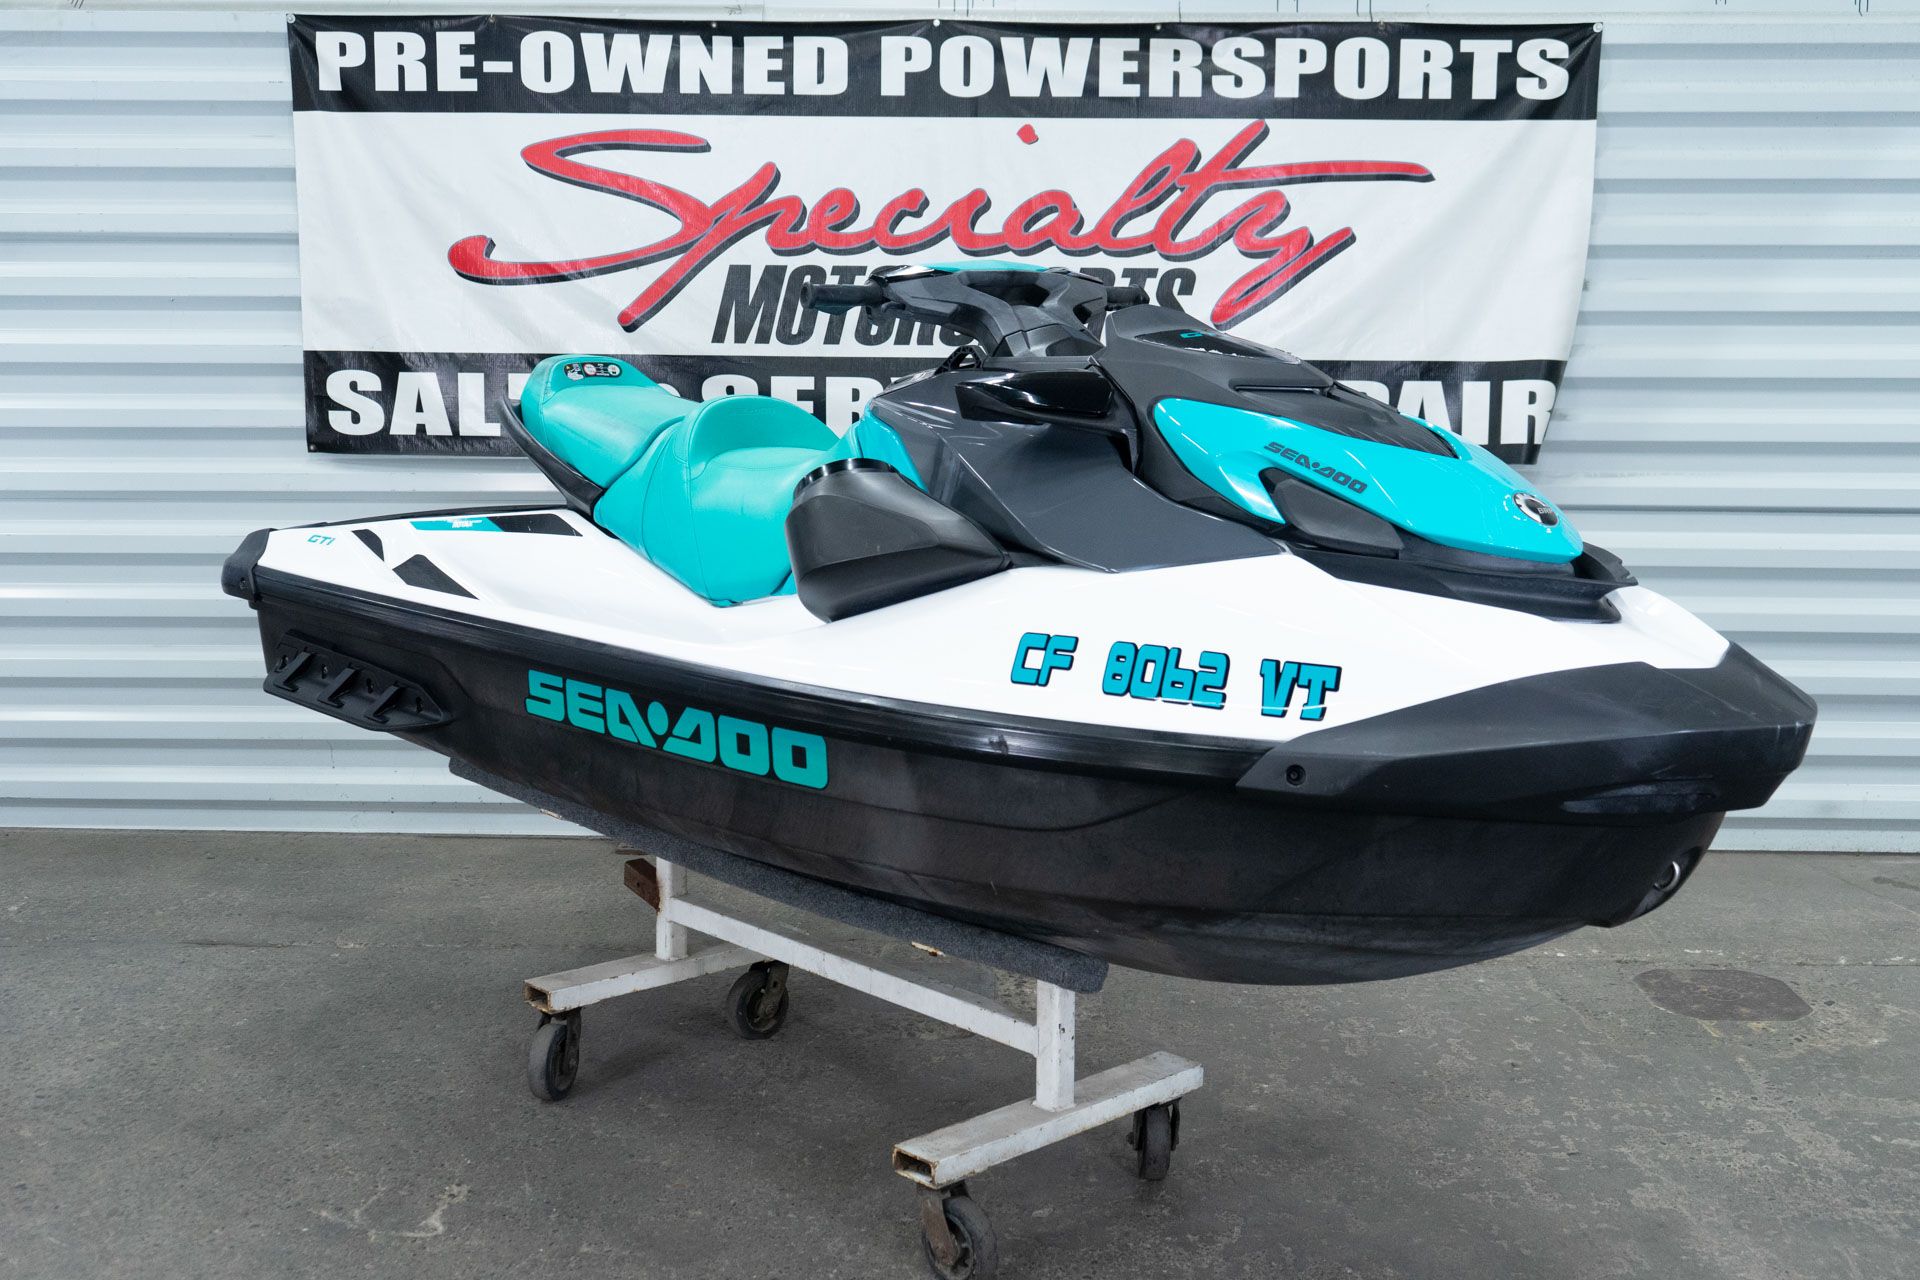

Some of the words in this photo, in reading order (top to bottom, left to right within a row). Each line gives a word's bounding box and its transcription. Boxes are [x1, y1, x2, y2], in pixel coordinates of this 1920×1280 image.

[315, 30, 849, 96] PRE-OWNED
[880, 35, 1570, 101] POWERSPORTS
[447, 118, 1436, 333] Specialty
[326, 369, 534, 436] SAL
[1010, 632, 1079, 686] CF
[1102, 641, 1231, 710] 8062
[1259, 658, 1342, 721] VT
